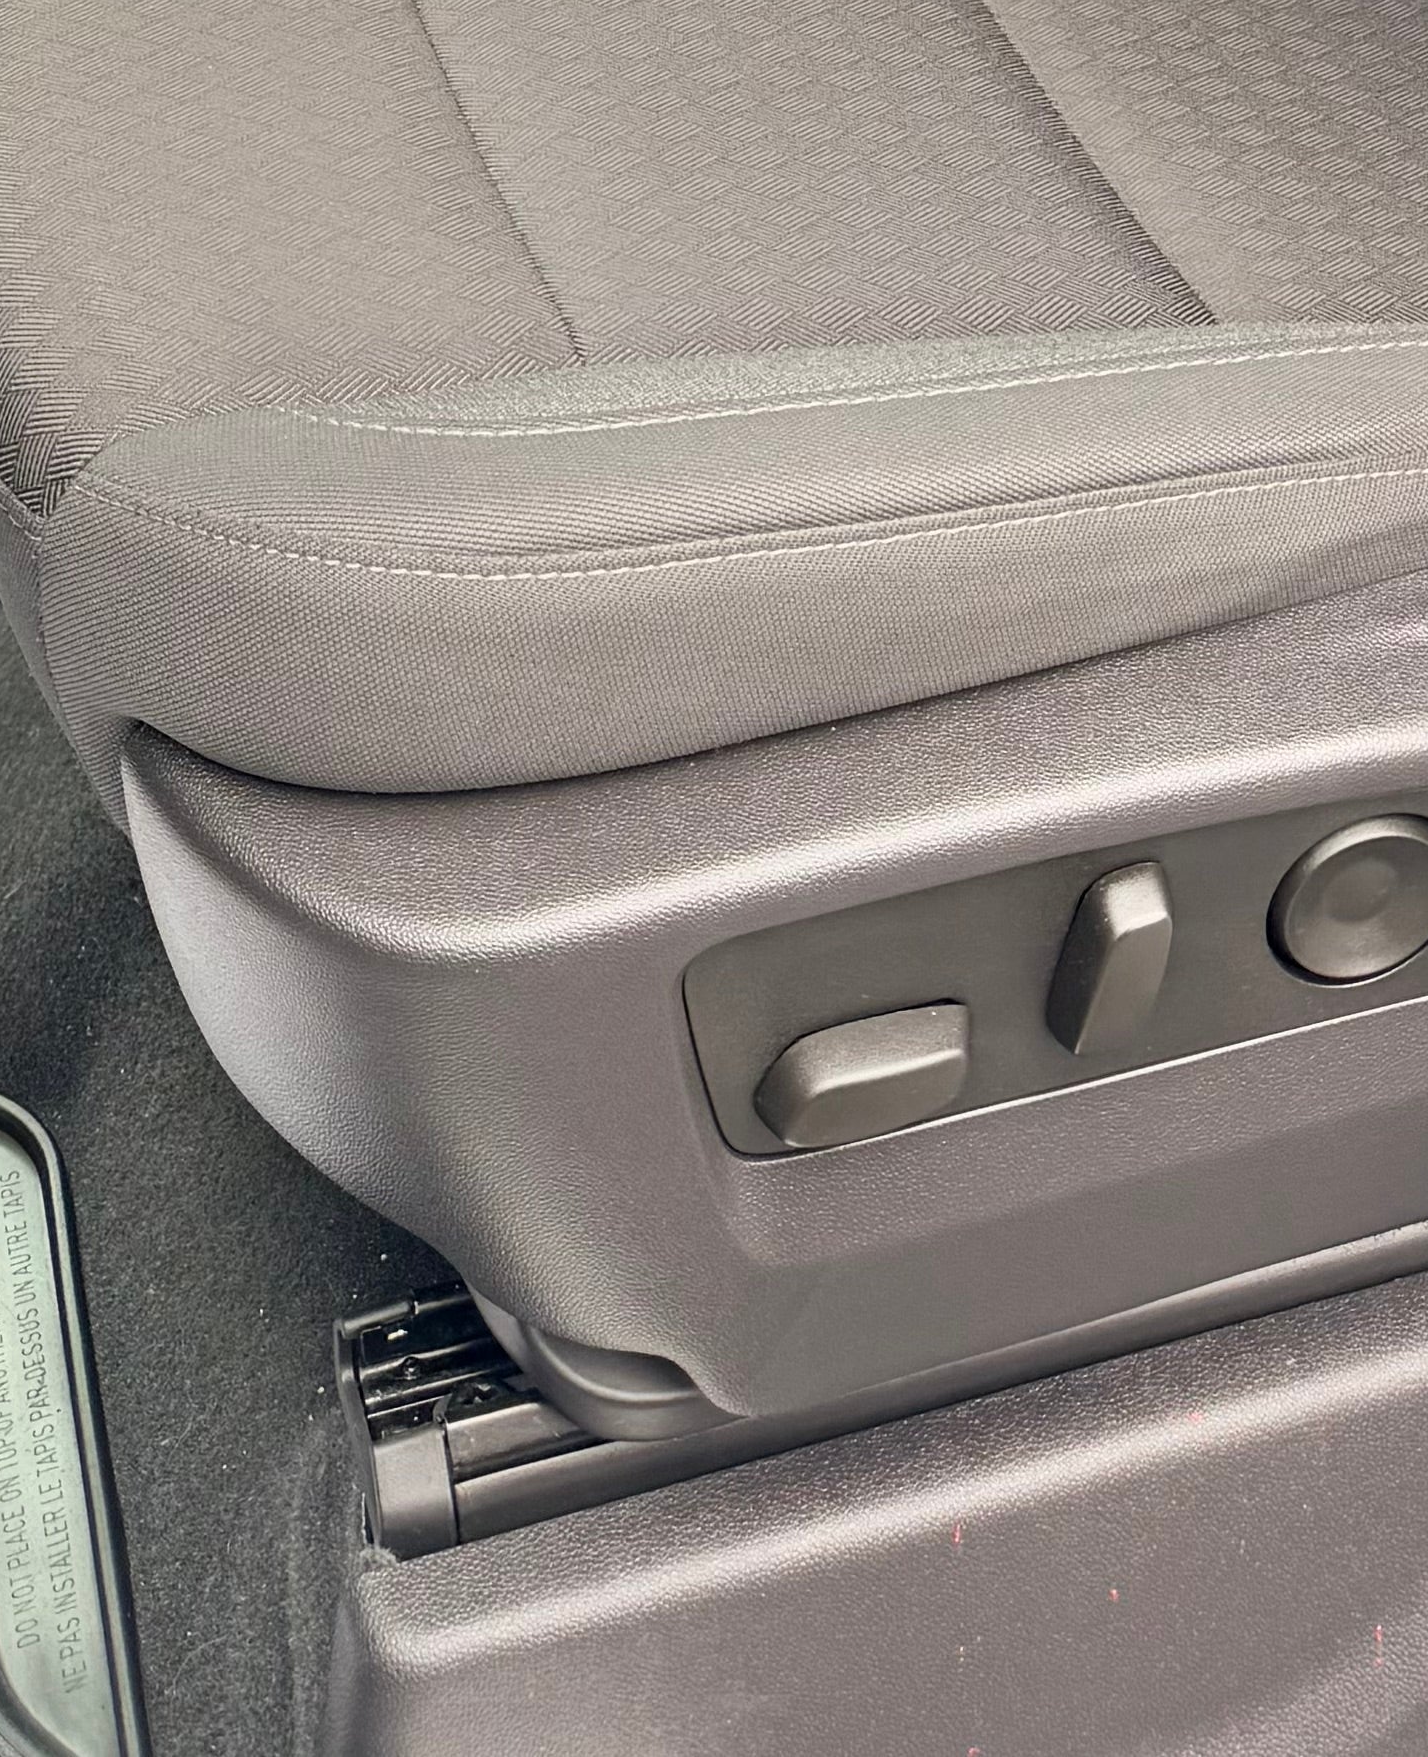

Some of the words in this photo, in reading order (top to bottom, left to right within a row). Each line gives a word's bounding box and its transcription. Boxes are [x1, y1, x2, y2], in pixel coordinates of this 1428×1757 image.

[0, 1170, 26, 1218] TAPIS
[4, 1220, 33, 1279] AUTRE
[13, 1279, 36, 1306] UN
[32, 1423, 59, 1478] TAPIS
[38, 1479, 63, 1505] LE
[1, 1505, 29, 1571] PLACE
[42, 1507, 77, 1615] INSTALLER
[9, 1572, 35, 1616] NOT
[15, 1617, 41, 1649] DO
[56, 1617, 82, 1660] PAS
[62, 1660, 88, 1693] NE
